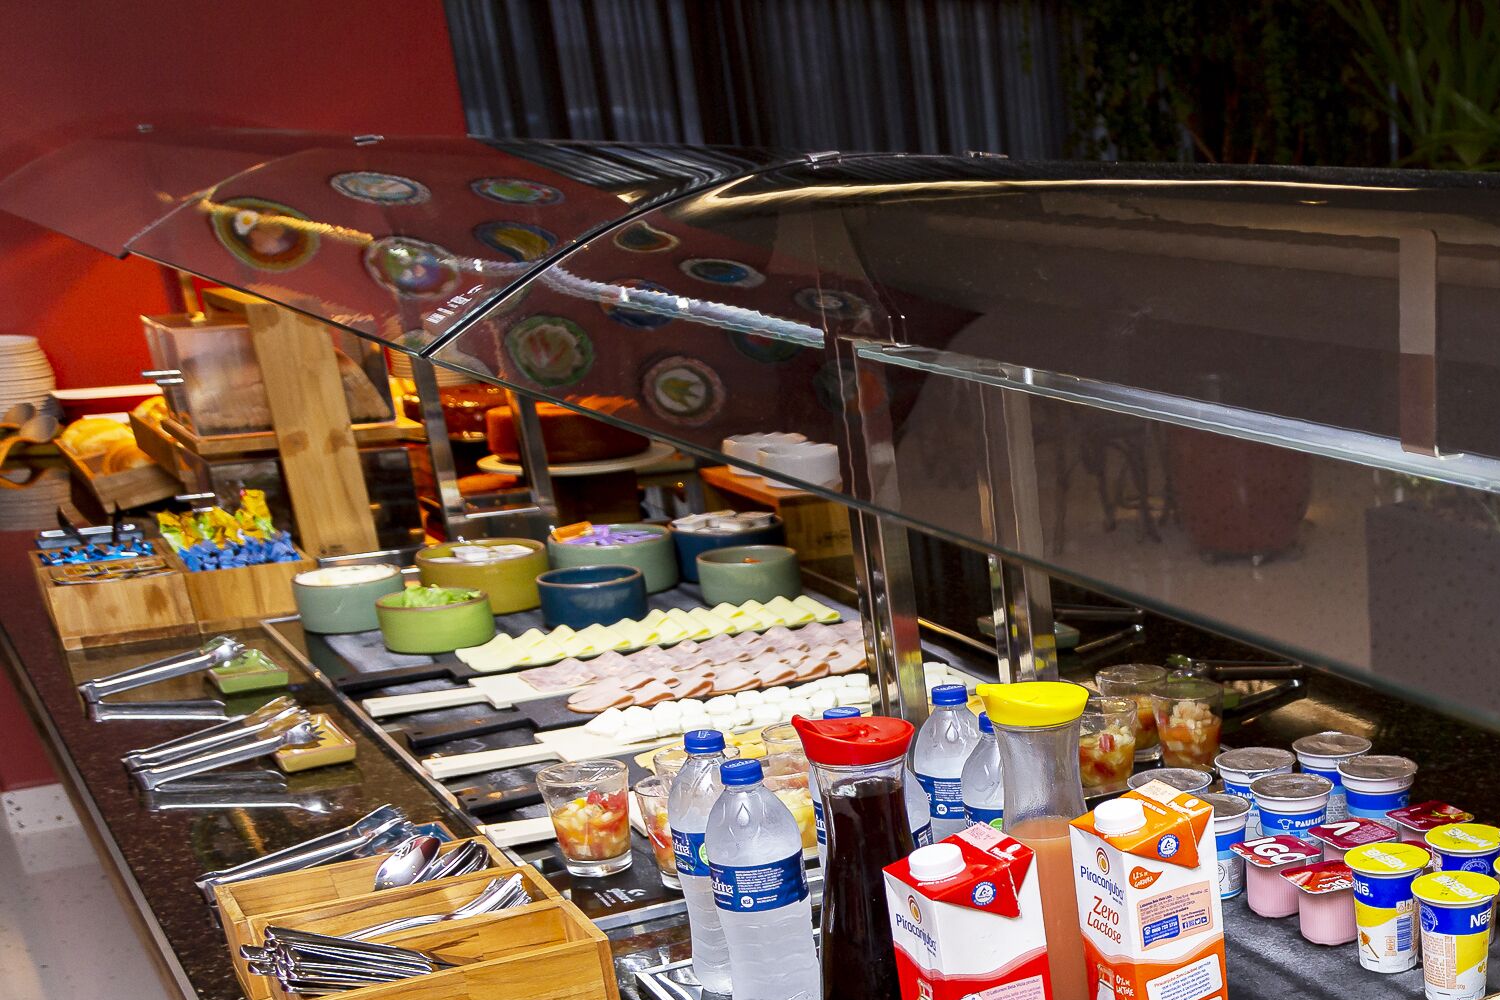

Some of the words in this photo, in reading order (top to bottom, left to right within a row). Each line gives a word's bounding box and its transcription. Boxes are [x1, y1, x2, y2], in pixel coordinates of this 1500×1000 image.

[1080, 865, 1124, 900] Piracanjuba
[1093, 895, 1120, 926] Zero
[896, 913, 937, 951] Piracanjuba
[1087, 911, 1122, 945] Lactose
